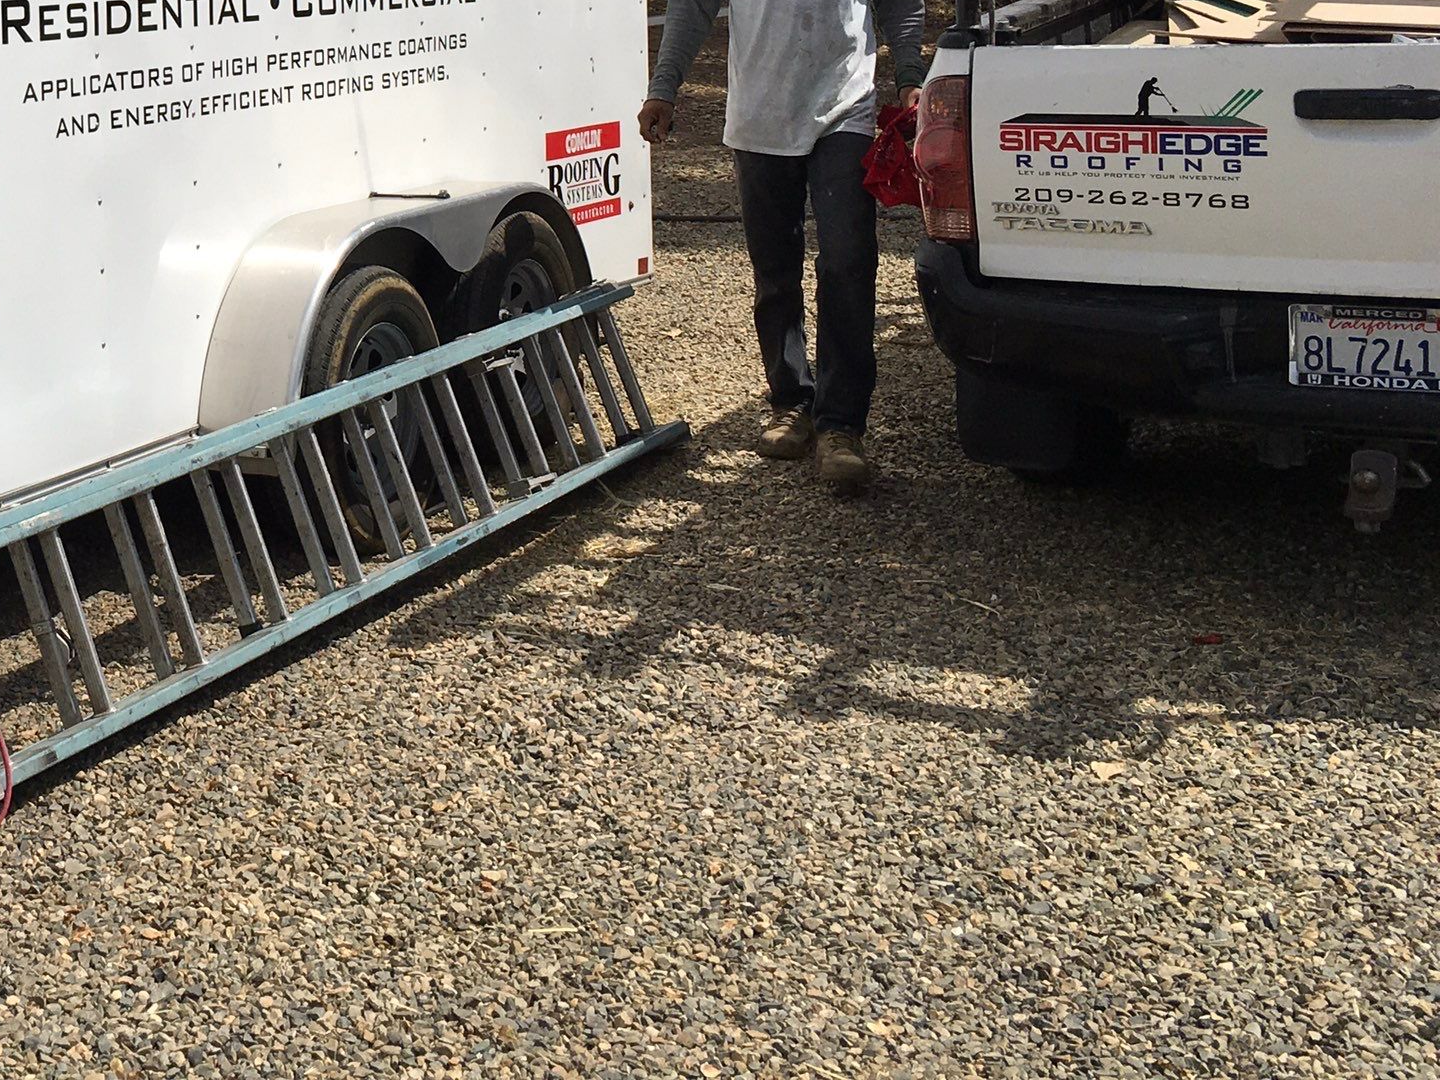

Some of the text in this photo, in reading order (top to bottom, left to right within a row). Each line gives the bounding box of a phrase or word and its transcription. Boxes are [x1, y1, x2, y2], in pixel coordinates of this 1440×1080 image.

[22, 33, 468, 104] APPLICATORS OF HIGH PERFORMANCE COATINGS
[56, 112, 100, 138] AND
[200, 85, 294, 116] EFFICIENT
[301, 74, 374, 101] ROOFING
[381, 65, 450, 89] SYSTEMS.
[1016, 154, 1242, 174] ROOFING
[1179, 174, 1241, 182] INVESTMENT
[566, 183, 603, 205] SYSTEMS
[1014, 187, 1250, 210] 209-262-8768
[577, 204, 614, 222] CONTRACTOR
[991, 201, 1060, 216] TOYOTA
[993, 215, 1152, 236] TACOMA
[1335, 307, 1422, 319] MERCED
[1328, 317, 1437, 336] California
[1303, 335, 1436, 377] 8L7241
[1333, 375, 1429, 391] HONDA
